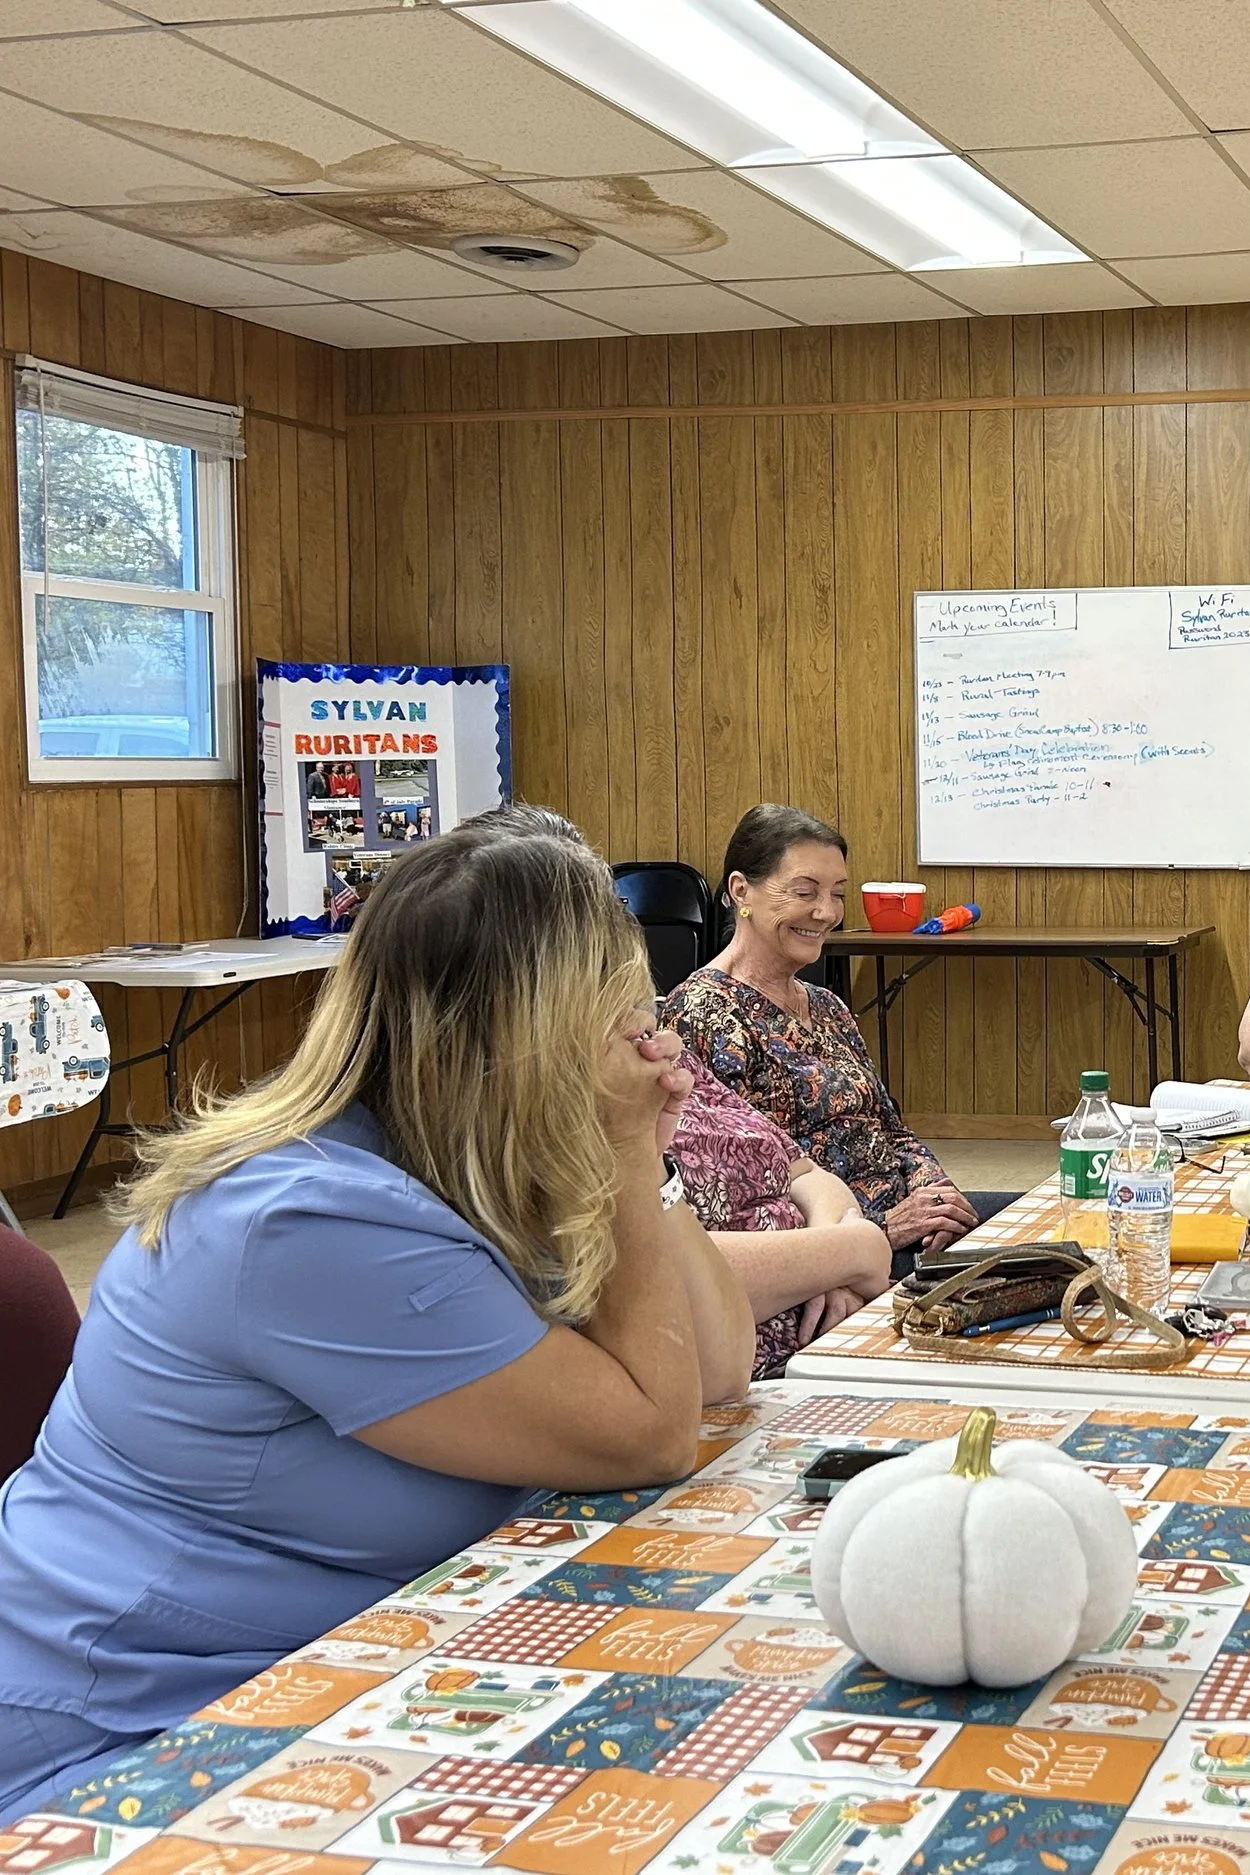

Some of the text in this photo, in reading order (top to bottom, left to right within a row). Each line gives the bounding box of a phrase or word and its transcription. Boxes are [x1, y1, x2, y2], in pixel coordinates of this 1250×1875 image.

[939, 596, 1056, 617] Upcoming Events
[929, 619, 959, 632] Mark
[964, 622, 989, 636] your
[1181, 608, 1217, 627] Sylvan
[310, 699, 427, 722] SYLVAN
[294, 732, 439, 755] RURITANS
[957, 729, 984, 742] Blood
[1014, 745, 1037, 759] Day
[1136, 1191, 1162, 1202] WATER
[894, 1420, 948, 1433] FEELS
[1192, 1471, 1240, 1503] fall
[632, 1533, 734, 1553] fall
[633, 1549, 704, 1567] FEELS
[600, 1619, 718, 1644] fall
[600, 1640, 682, 1661] FEELS
[986, 1732, 1057, 1792] fall
[576, 1791, 673, 1824] FEELS
[528, 1815, 676, 1854] fall
[1131, 1834, 1170, 1849] NICE
[1173, 1833, 1198, 1842] ME
